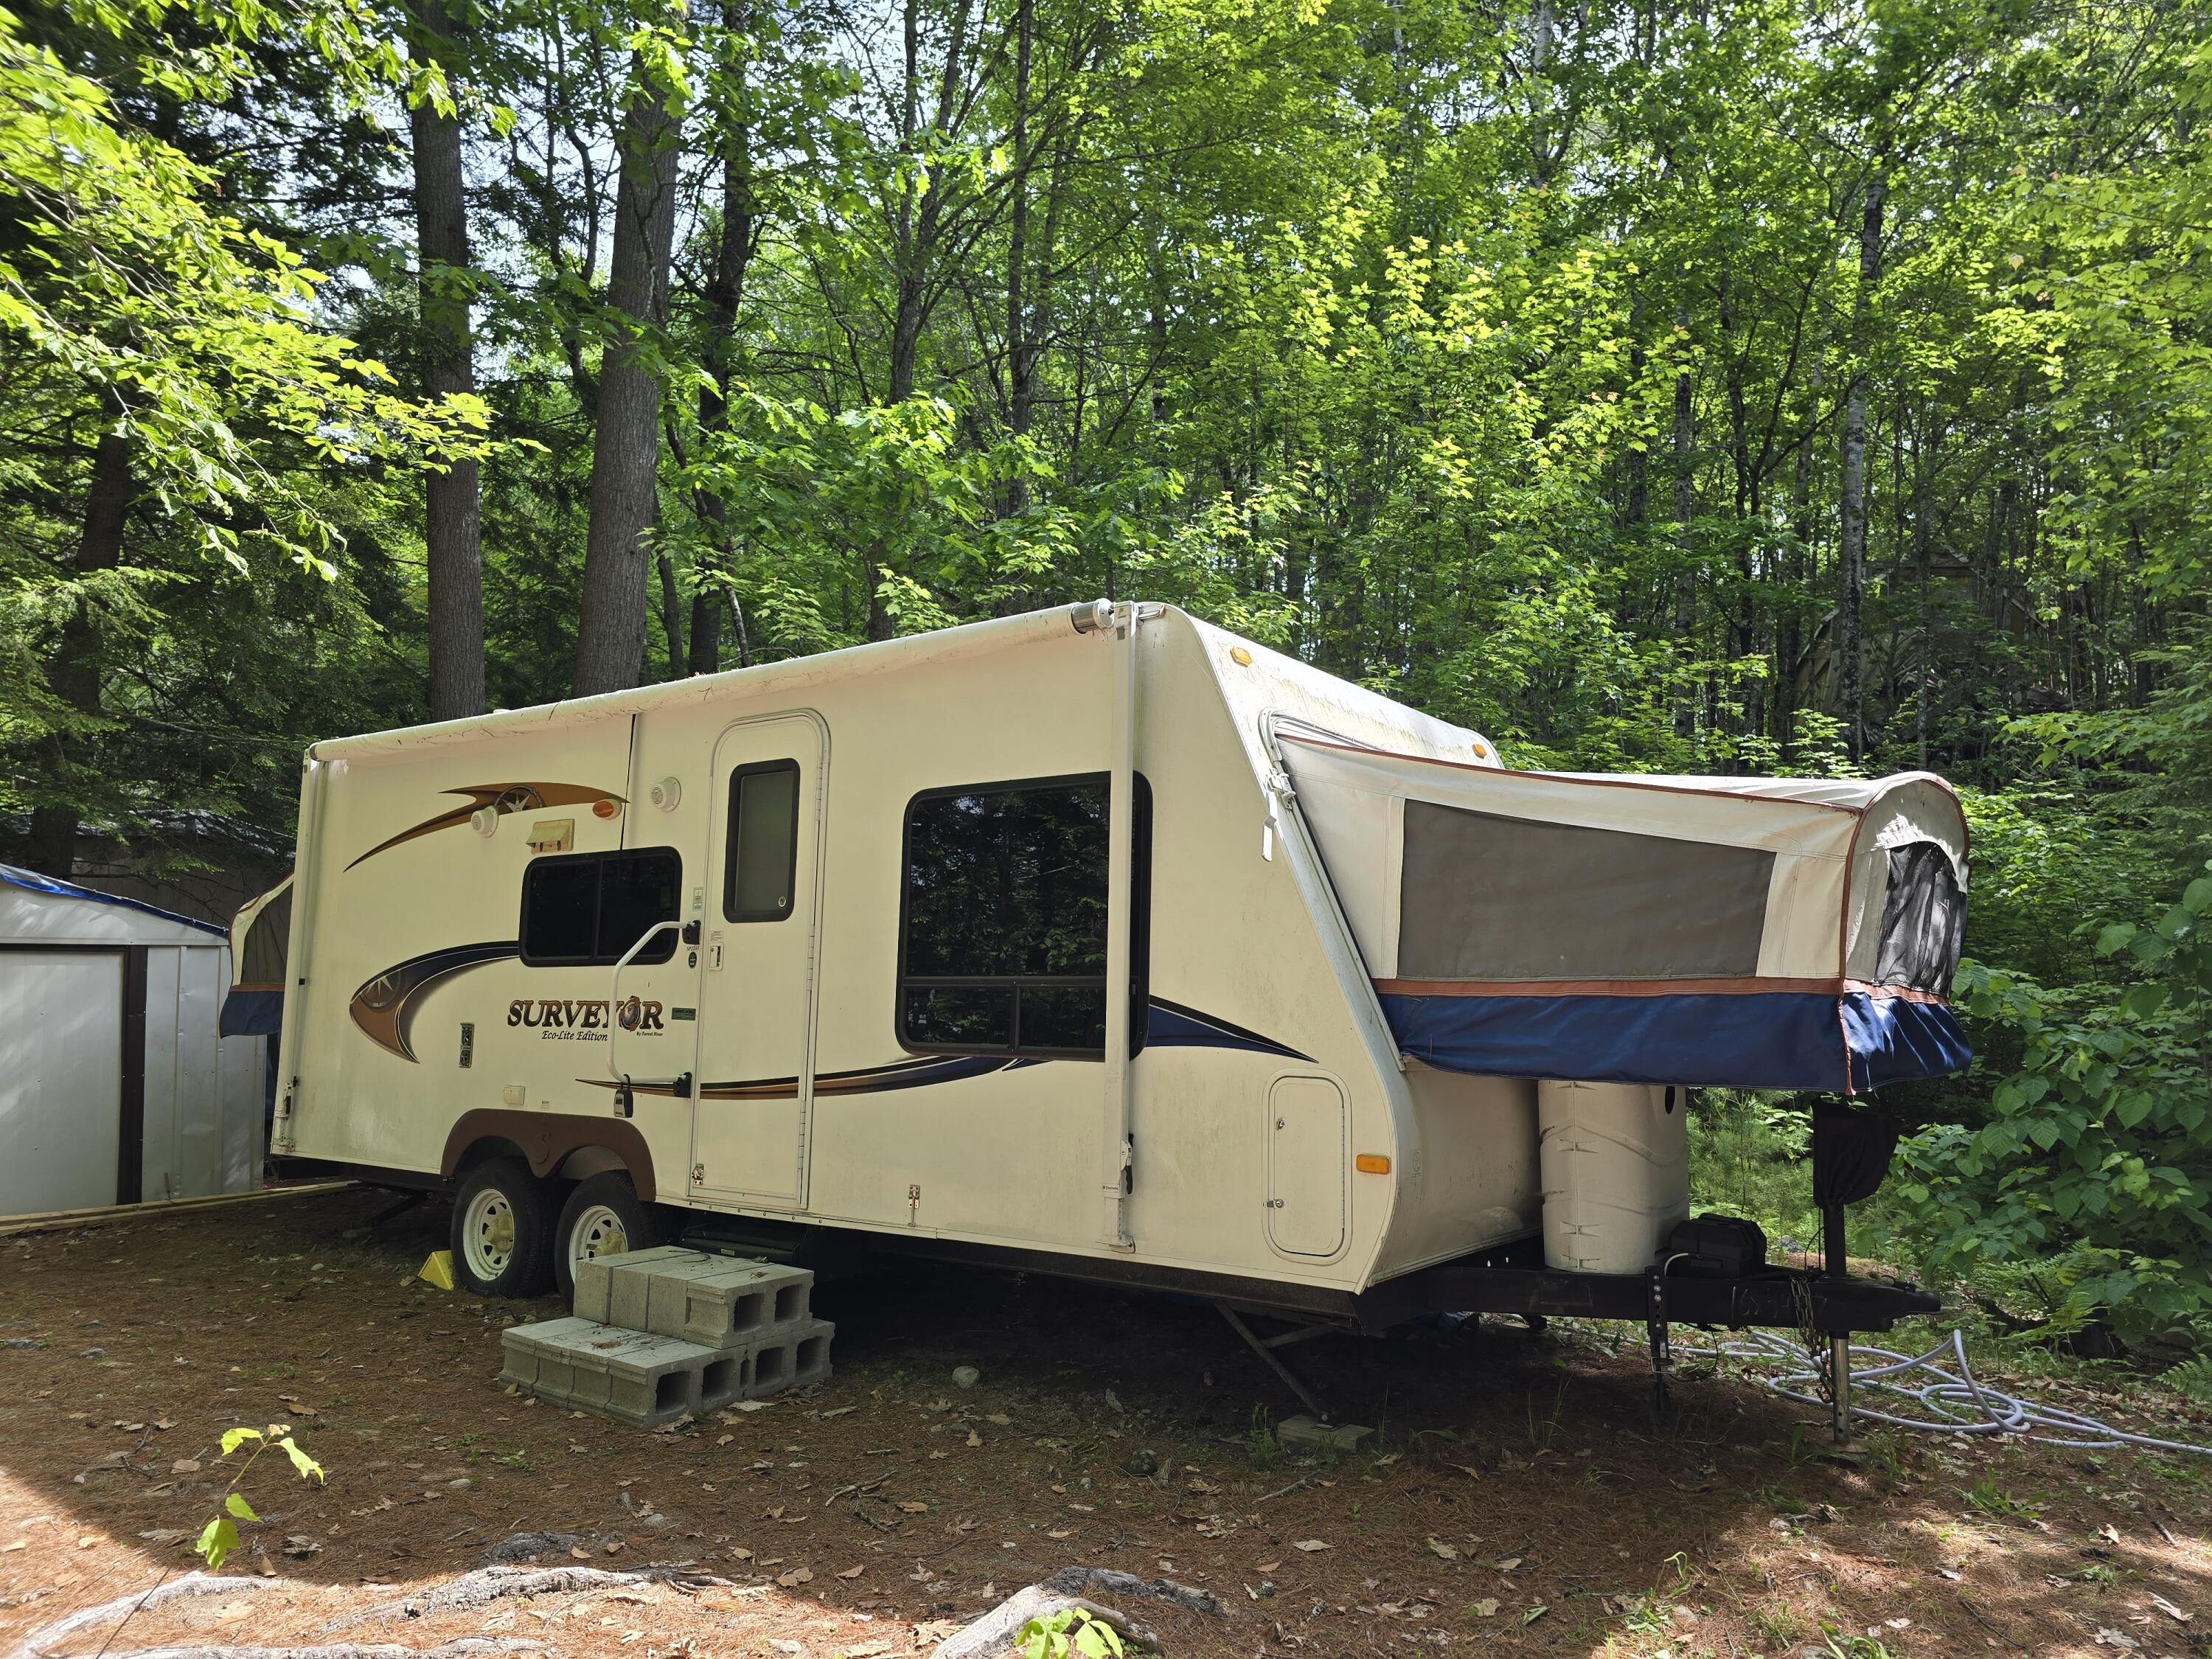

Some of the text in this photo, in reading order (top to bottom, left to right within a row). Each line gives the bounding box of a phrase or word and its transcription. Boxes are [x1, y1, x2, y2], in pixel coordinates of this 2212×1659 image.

[507, 997, 664, 1031] SURVEYOR
[541, 1030, 608, 1041] Eco-Lite Edition
